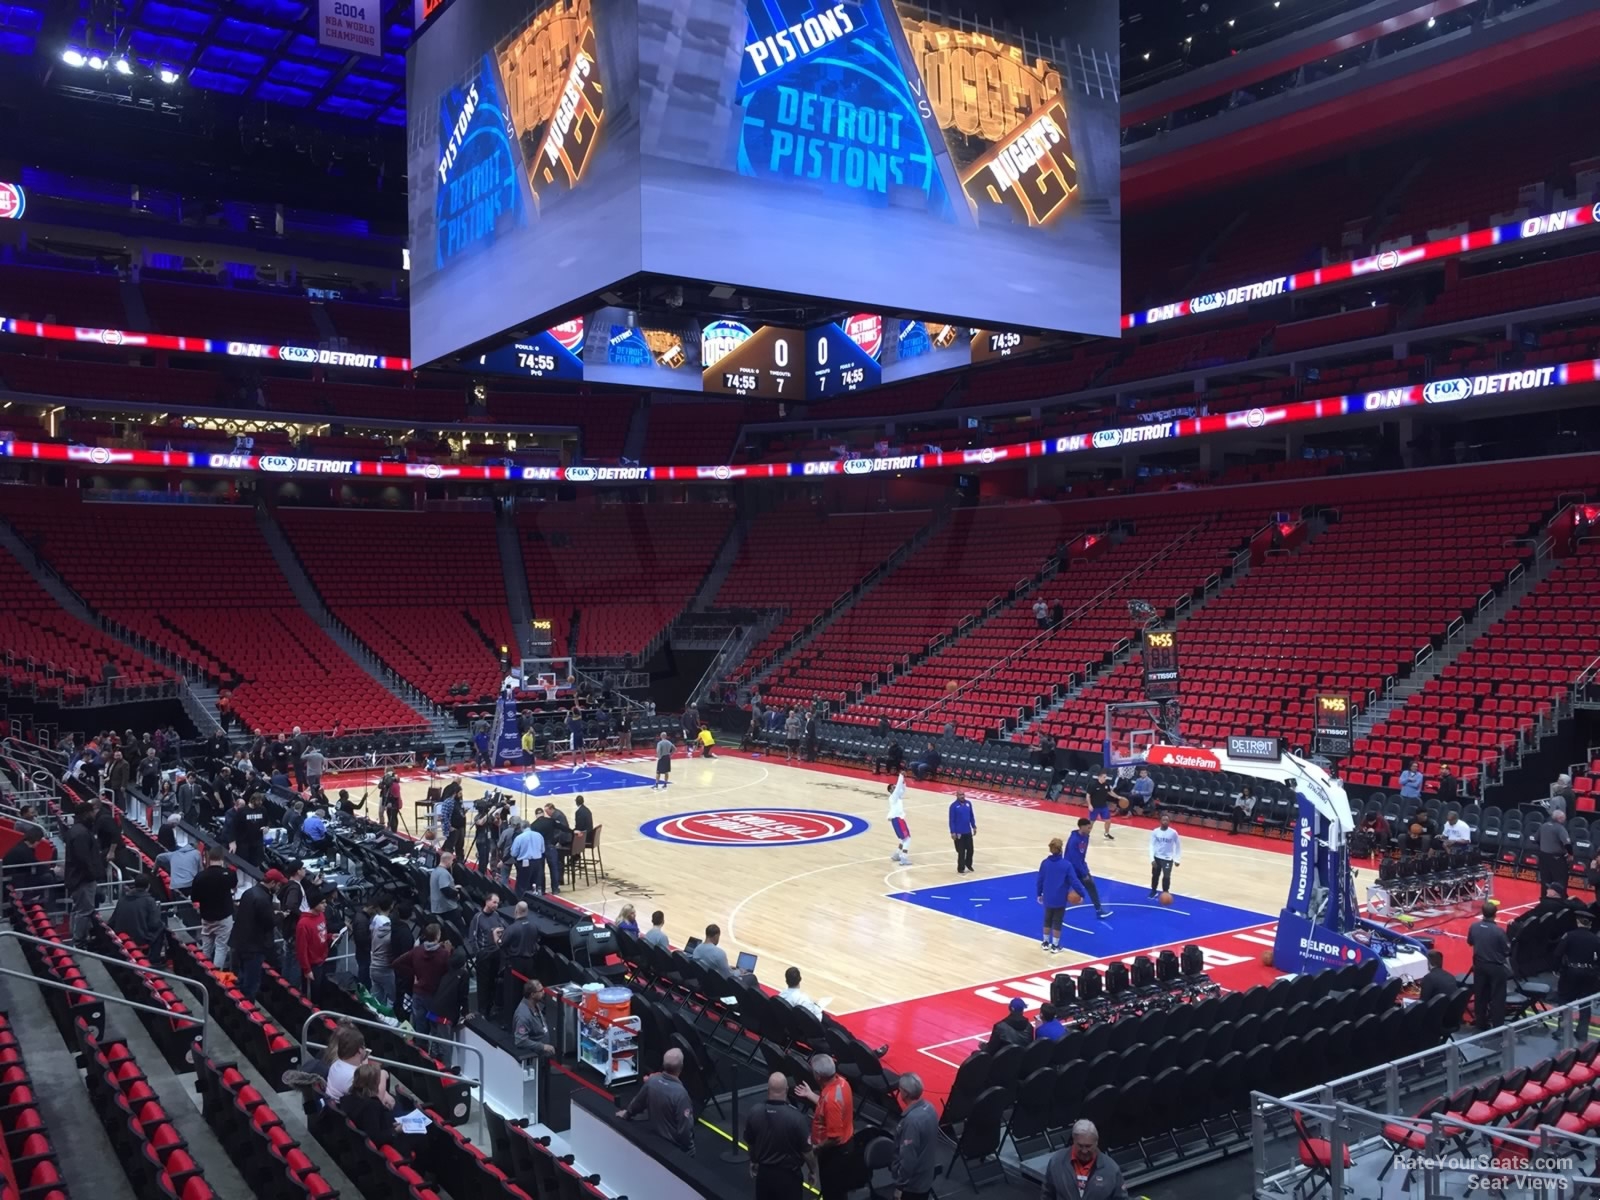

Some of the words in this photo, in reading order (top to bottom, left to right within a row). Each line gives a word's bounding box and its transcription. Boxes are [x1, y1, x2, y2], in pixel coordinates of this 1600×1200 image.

[334, 2, 366, 20] 2004
[325, 16, 343, 28] NBA
[345, 20, 375, 34] WORLD
[325, 28, 375, 47] CHAMPIONS
[745, 4, 854, 76] PISTONS
[777, 85, 904, 150] DETROIT
[438, 83, 479, 185] PISTONS
[770, 130, 905, 194] PISTONS
[988, 115, 1061, 192] NUGGETS
[1197, 294, 1219, 306] FOX
[991, 332, 1021, 351] 74:55
[288, 347, 310, 358] FOX
[775, 339, 788, 367] 0
[818, 337, 828, 366] 0
[518, 352, 555, 371] 74:55
[725, 374, 757, 391] 74:55
[776, 378, 785, 393] 7
[819, 376, 826, 392] 7
[841, 367, 864, 386] 74:55
[1434, 380, 1460, 396] FOX
[1099, 431, 1116, 443] FOX
[267, 457, 289, 467] FOX
[850, 460, 868, 470] FOX
[572, 468, 590, 478] FOX
[1231, 740, 1273, 752] DETROIT
[1297, 851, 1308, 901] VISION
[1300, 937, 1341, 957] BELFOR
